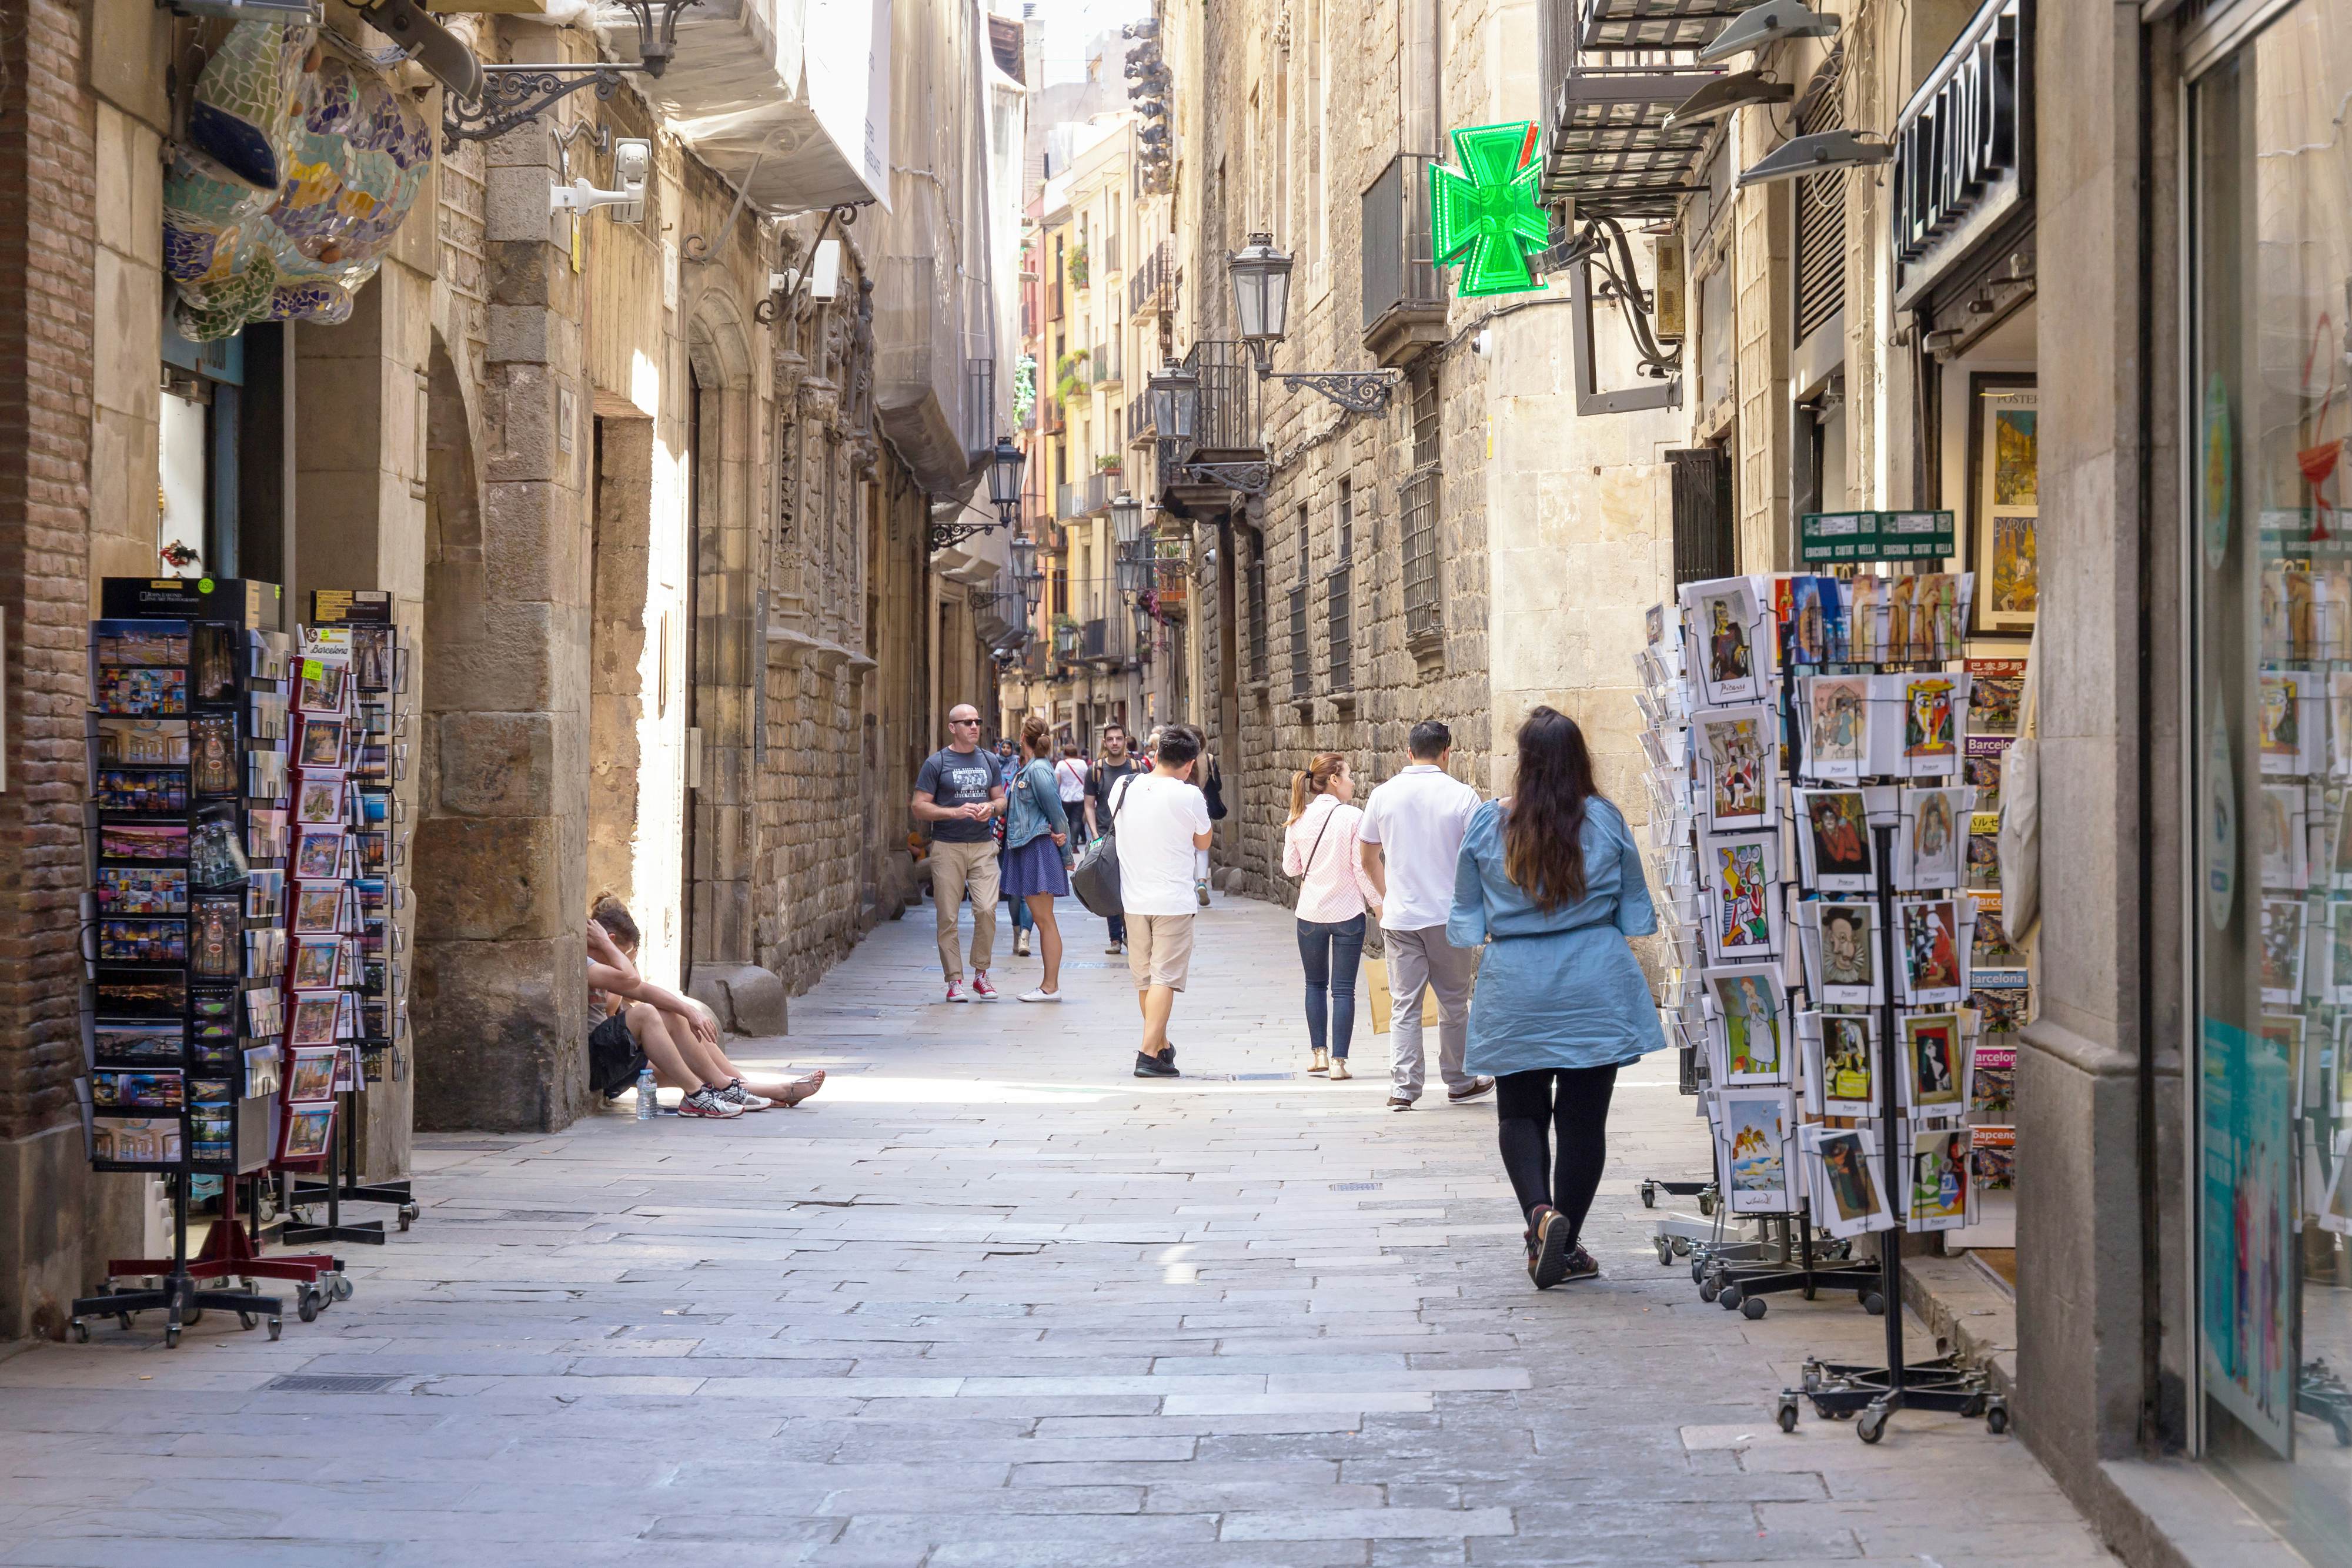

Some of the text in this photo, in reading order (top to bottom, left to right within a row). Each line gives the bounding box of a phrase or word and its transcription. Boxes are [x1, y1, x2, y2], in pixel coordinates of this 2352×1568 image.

[310, 644, 348, 654] Barcelona
[1971, 662, 2023, 671] 巴塞罗那
[1969, 739, 2012, 750] Barcelo
